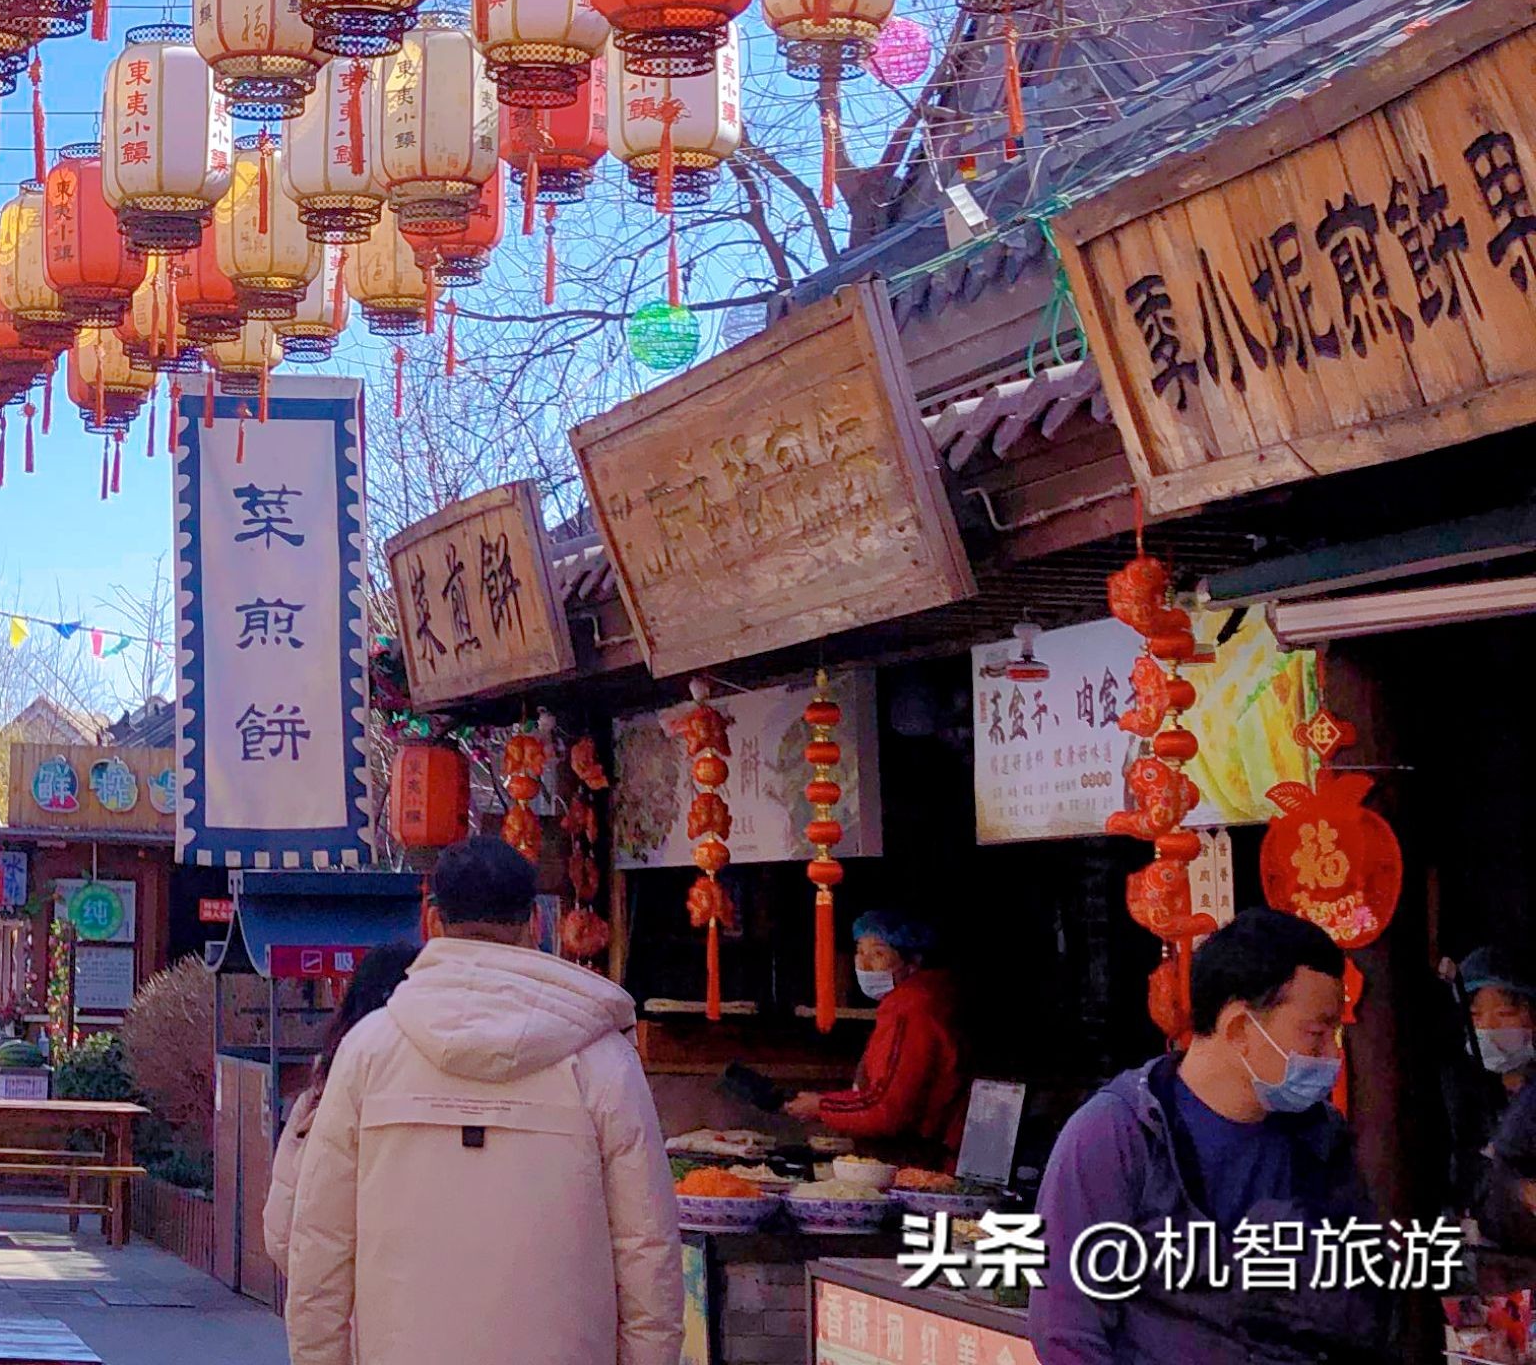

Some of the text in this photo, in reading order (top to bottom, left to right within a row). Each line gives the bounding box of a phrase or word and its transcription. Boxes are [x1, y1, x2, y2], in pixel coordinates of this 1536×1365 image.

[121, 59, 151, 166] 東夷小鎮
[394, 58, 417, 150] 東夷小鎮
[233, 482, 311, 761] 菜煎餅
[1291, 819, 1351, 891] 福
